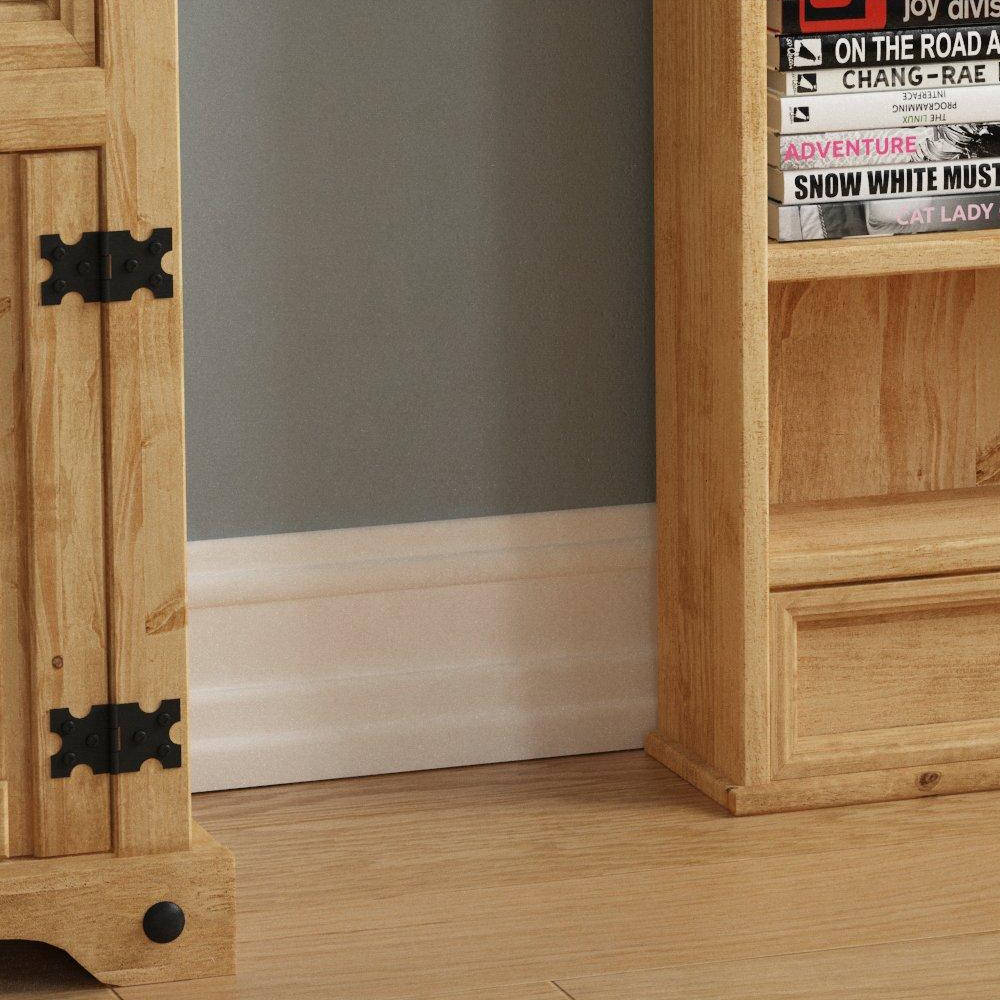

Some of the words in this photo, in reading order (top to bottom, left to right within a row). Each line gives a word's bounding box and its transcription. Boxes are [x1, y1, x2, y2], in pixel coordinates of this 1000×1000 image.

[835, 37, 866, 64] ON
[874, 33, 914, 61] THE
[920, 29, 982, 59] ROAD
[842, 64, 986, 89] CHANG-RAE
[902, 90, 946, 100] INTERFACE
[892, 101, 957, 113] PROGRAMMING
[930, 113, 946, 122] THE
[903, 114, 927, 124] LINUX
[784, 136, 917, 162] ADVENTURE
[794, 171, 862, 200] SNOW
[867, 166, 937, 195] WHITE
[896, 204, 934, 225] CAT
[940, 203, 993, 222] LADY
